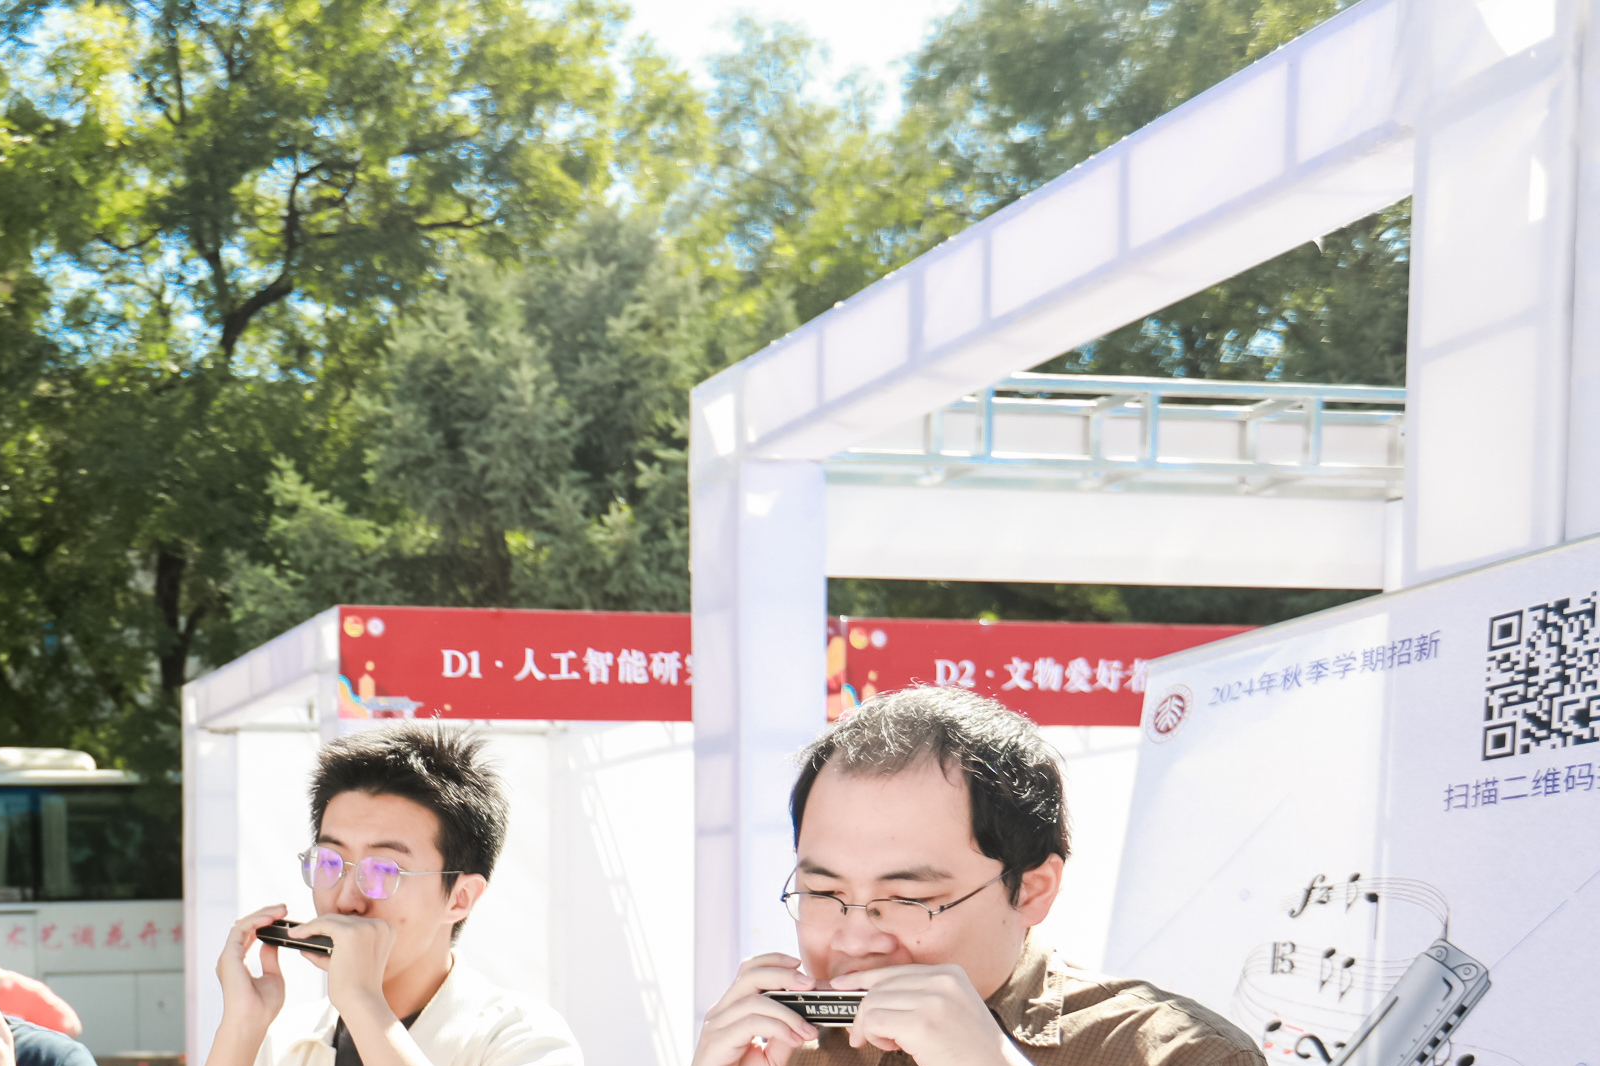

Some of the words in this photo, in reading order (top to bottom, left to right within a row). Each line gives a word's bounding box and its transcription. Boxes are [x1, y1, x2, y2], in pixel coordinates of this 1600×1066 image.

[441, 647, 693, 686] D1·人工智能研
[1208, 630, 1441, 706] 2024年秋季学期招新
[1443, 762, 1600, 812] 扫描二维码
[805, 1004, 860, 1015] M.SUZU
